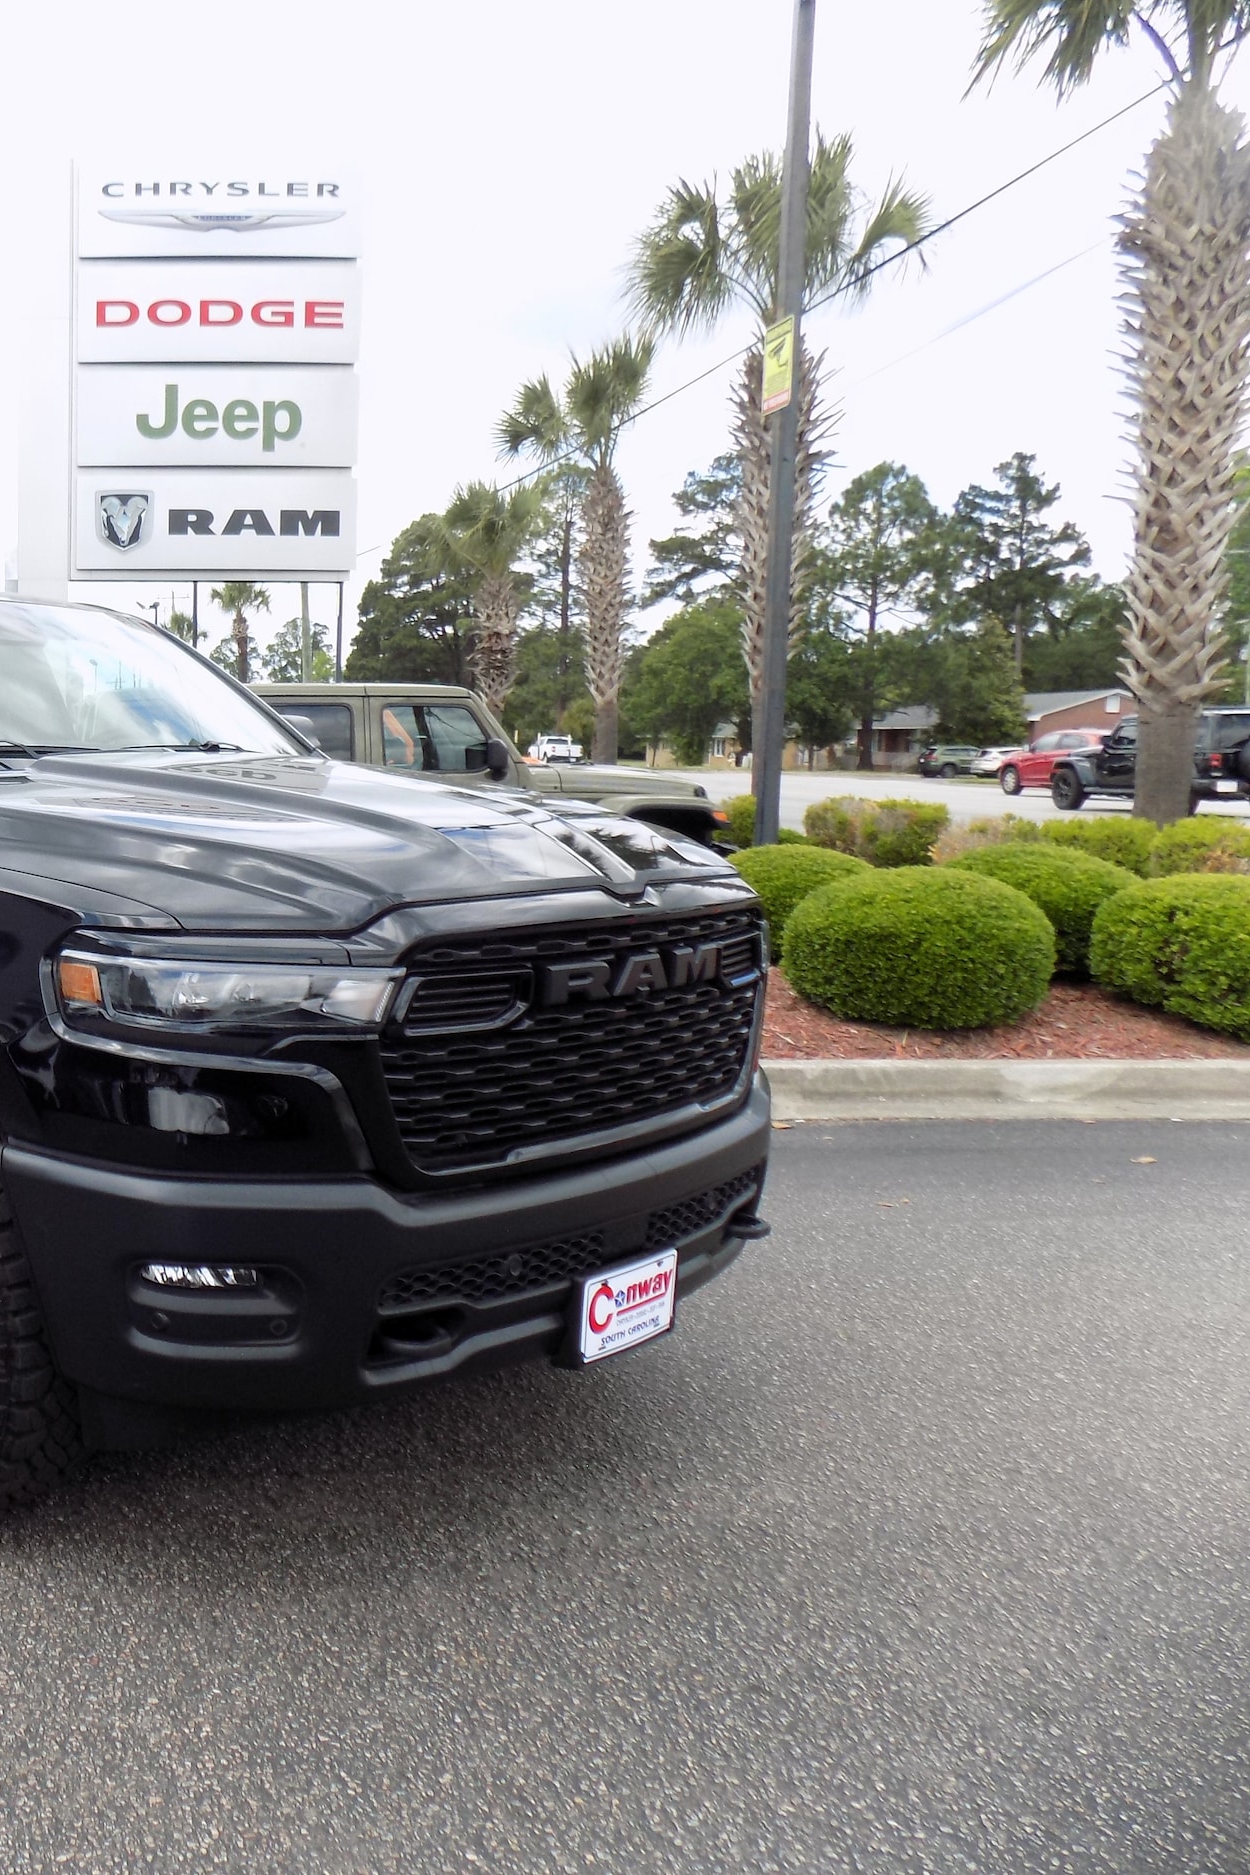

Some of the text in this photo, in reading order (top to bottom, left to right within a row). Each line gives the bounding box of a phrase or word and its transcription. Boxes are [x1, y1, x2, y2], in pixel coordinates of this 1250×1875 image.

[101, 181, 341, 198] CHRYSLER
[96, 300, 345, 329] DODGE
[136, 384, 302, 452] Jeep
[168, 508, 341, 537] RAM
[546, 943, 719, 1005] RAM
[600, 1329, 627, 1346] SOUTH
